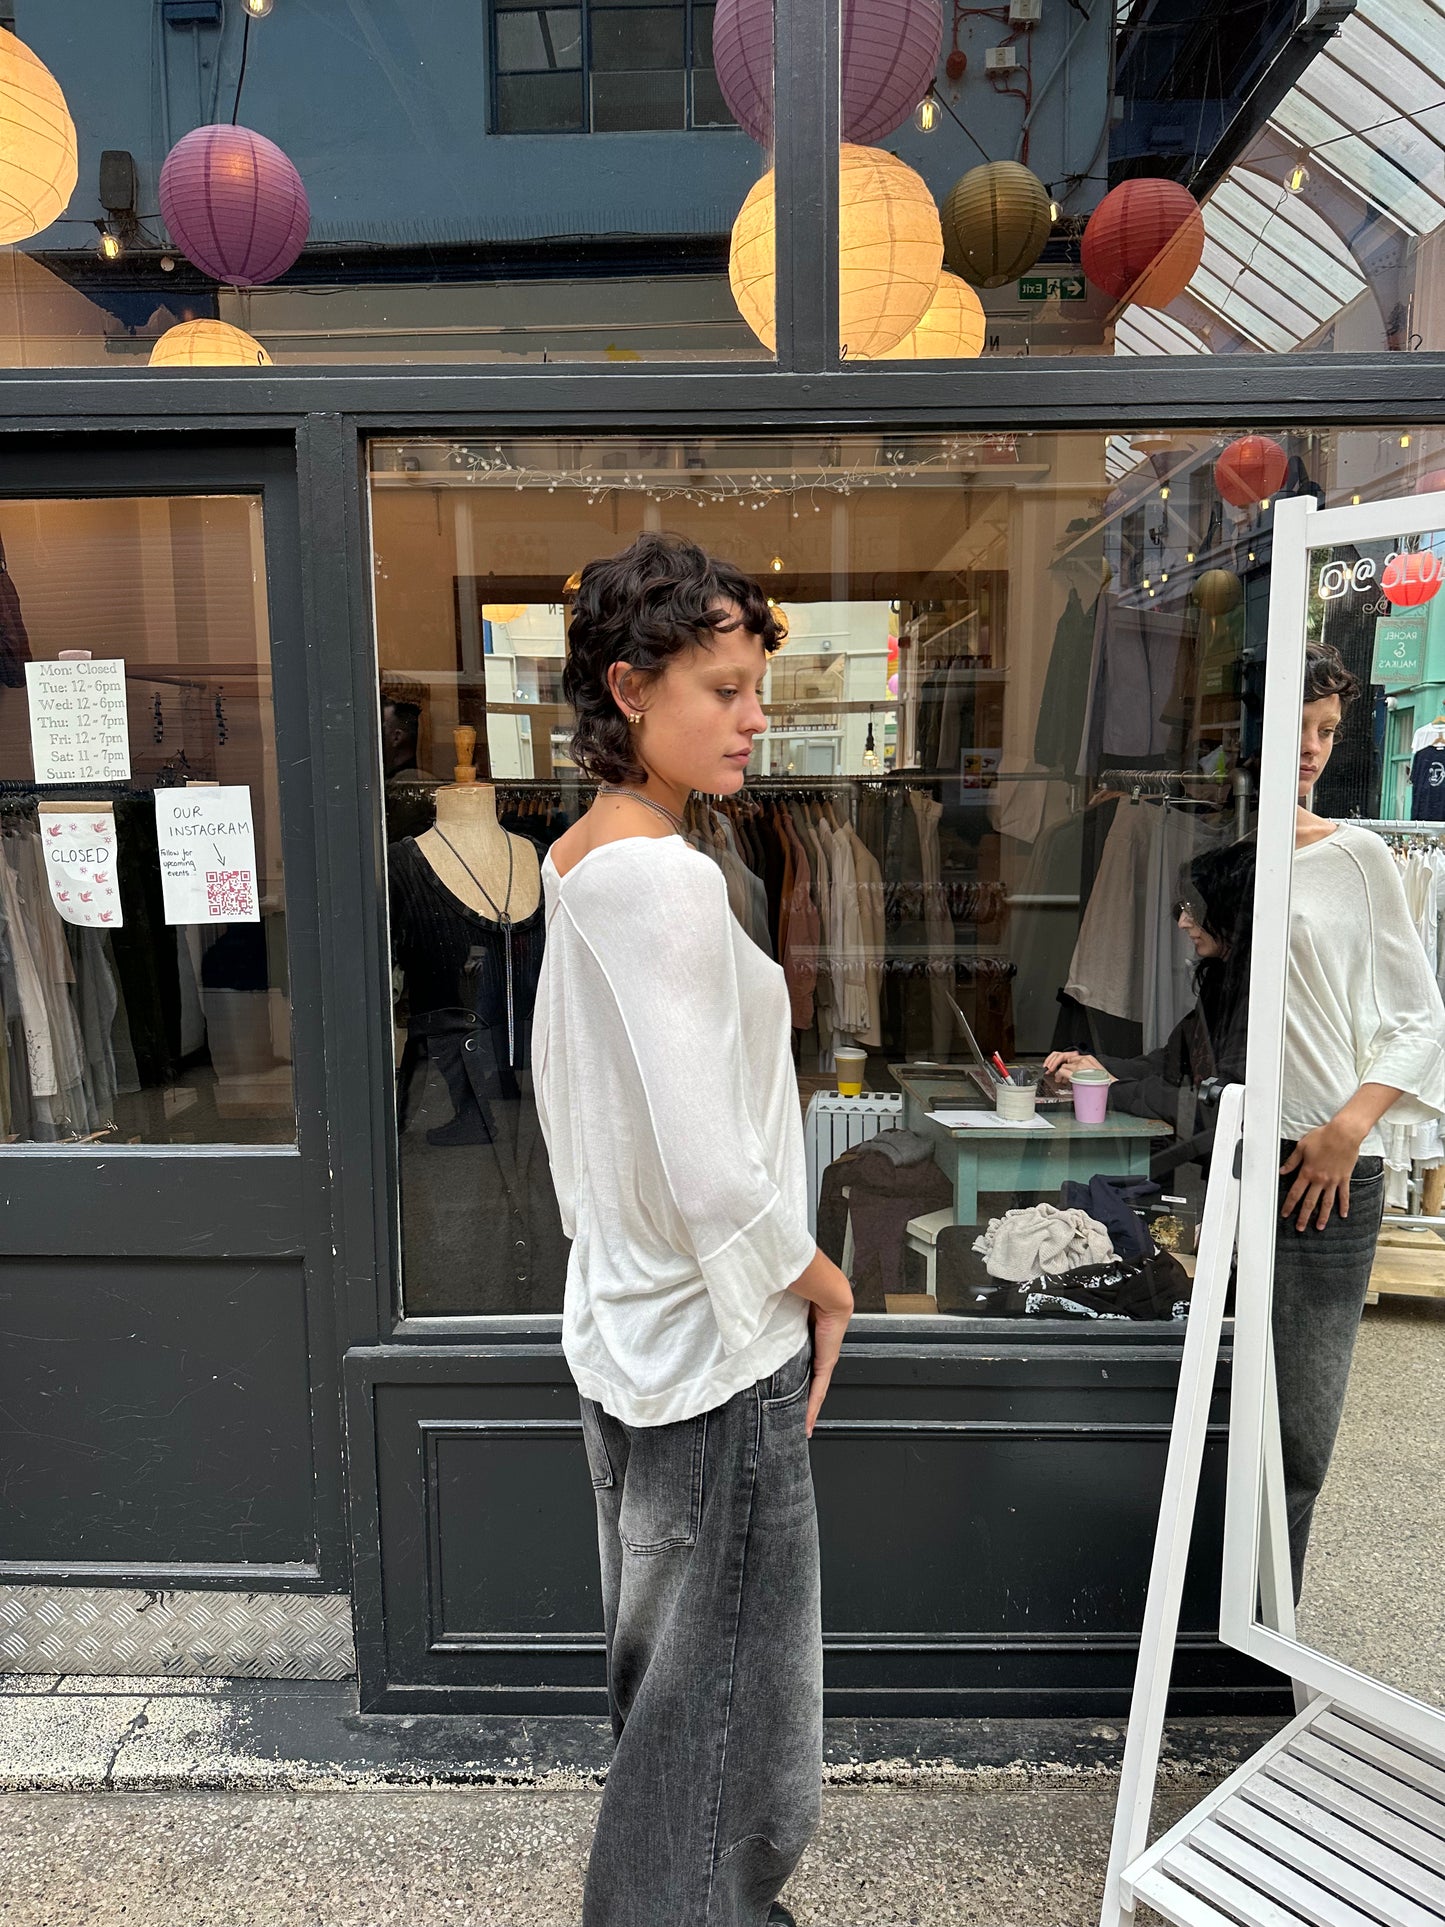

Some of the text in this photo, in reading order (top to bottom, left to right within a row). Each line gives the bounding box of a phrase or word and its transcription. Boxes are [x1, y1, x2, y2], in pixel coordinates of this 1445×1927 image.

[40, 662, 117, 676] Mon: Closed
[39, 682, 68, 693] Tue:
[72, 680, 86, 692] 12
[95, 679, 121, 694] 6pm
[38, 698, 73, 711] Wed:
[77, 697, 90, 710] 12
[100, 697, 125, 712] 6pm
[37, 716, 69, 728] Thu:
[77, 714, 91, 727] 12
[101, 714, 125, 729] 7pm
[49, 733, 72, 745] Fri:
[75, 731, 90, 744] 12
[99, 732, 123, 746] 7pm
[51, 751, 74, 762] Sat:
[78, 750, 90, 761] 11
[101, 749, 124, 763] 7pm
[47, 768, 75, 780] Sun:
[80, 765, 93, 778] 12
[103, 766, 127, 780] 6pm
[173, 806, 203, 819] OUR
[169, 822, 250, 837] INSTAGRAM
[51, 847, 109, 863] CLOSED
[160, 848, 192, 861] Follow for
[163, 860, 197, 872] upcoming
